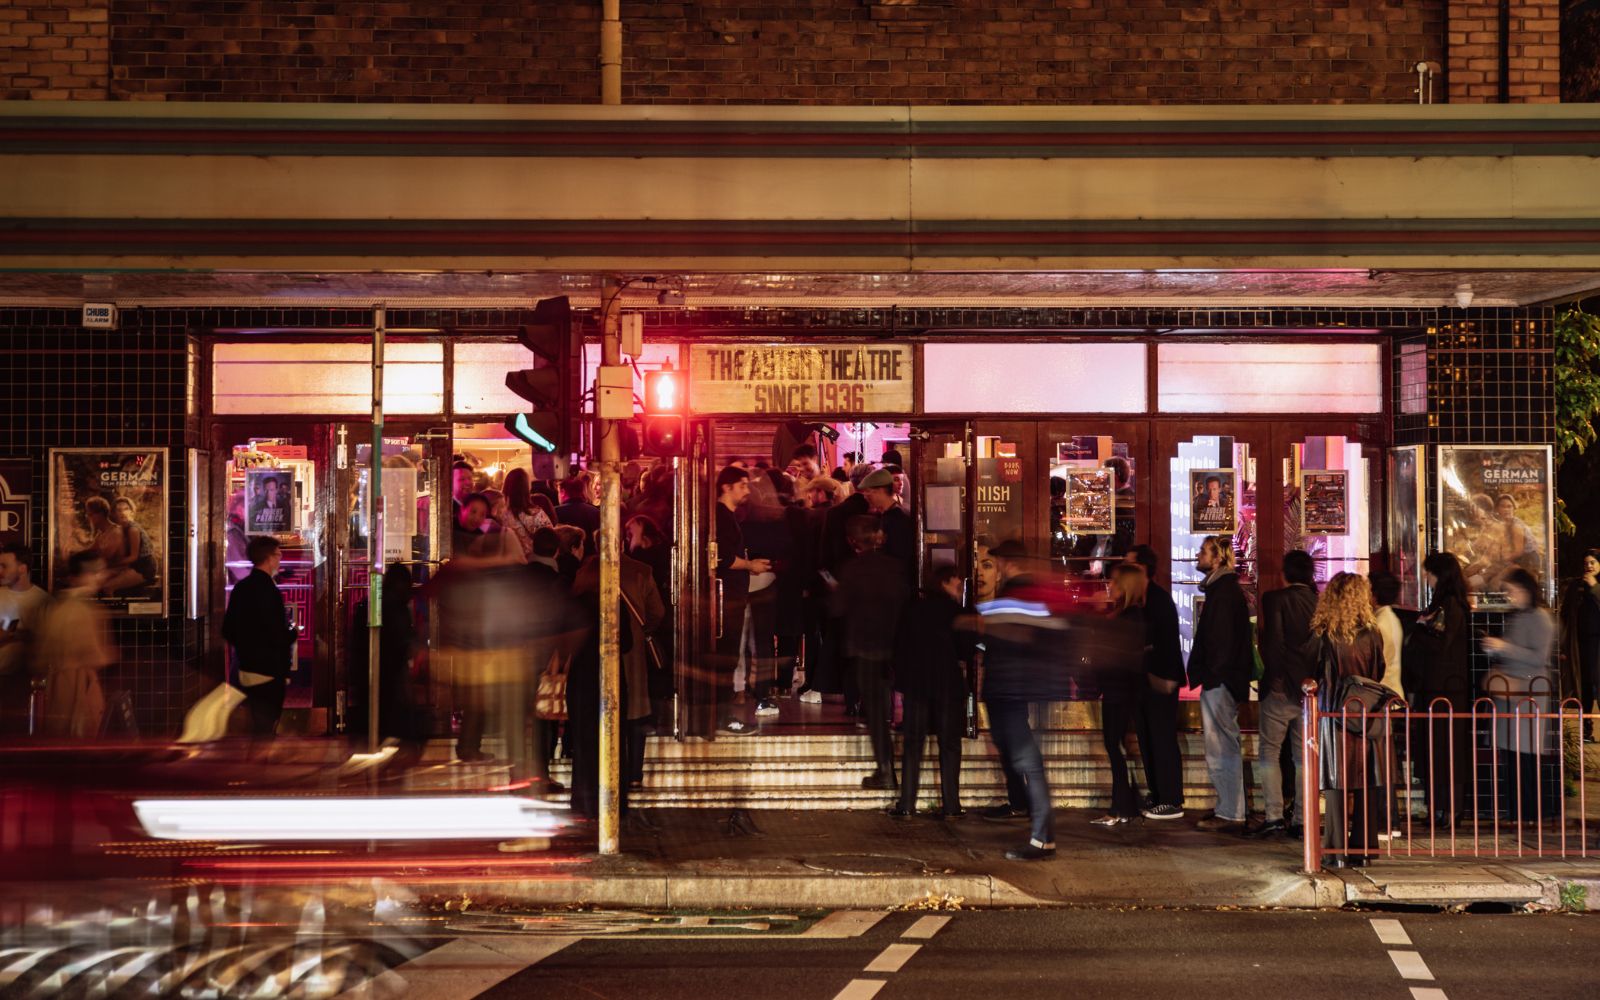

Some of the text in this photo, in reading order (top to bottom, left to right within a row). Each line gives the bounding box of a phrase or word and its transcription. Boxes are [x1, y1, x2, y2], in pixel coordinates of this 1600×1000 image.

[86, 307, 109, 316] CHUBB
[707, 349, 903, 381] THE ASTOR THEATRE
[100, 471, 158, 481] GERMAN
[1483, 469, 1539, 479] GERMAN
[976, 485, 1010, 501] NISH
[977, 505, 1007, 513] ESTIVAL
[1199, 513, 1226, 521] PATRICK
